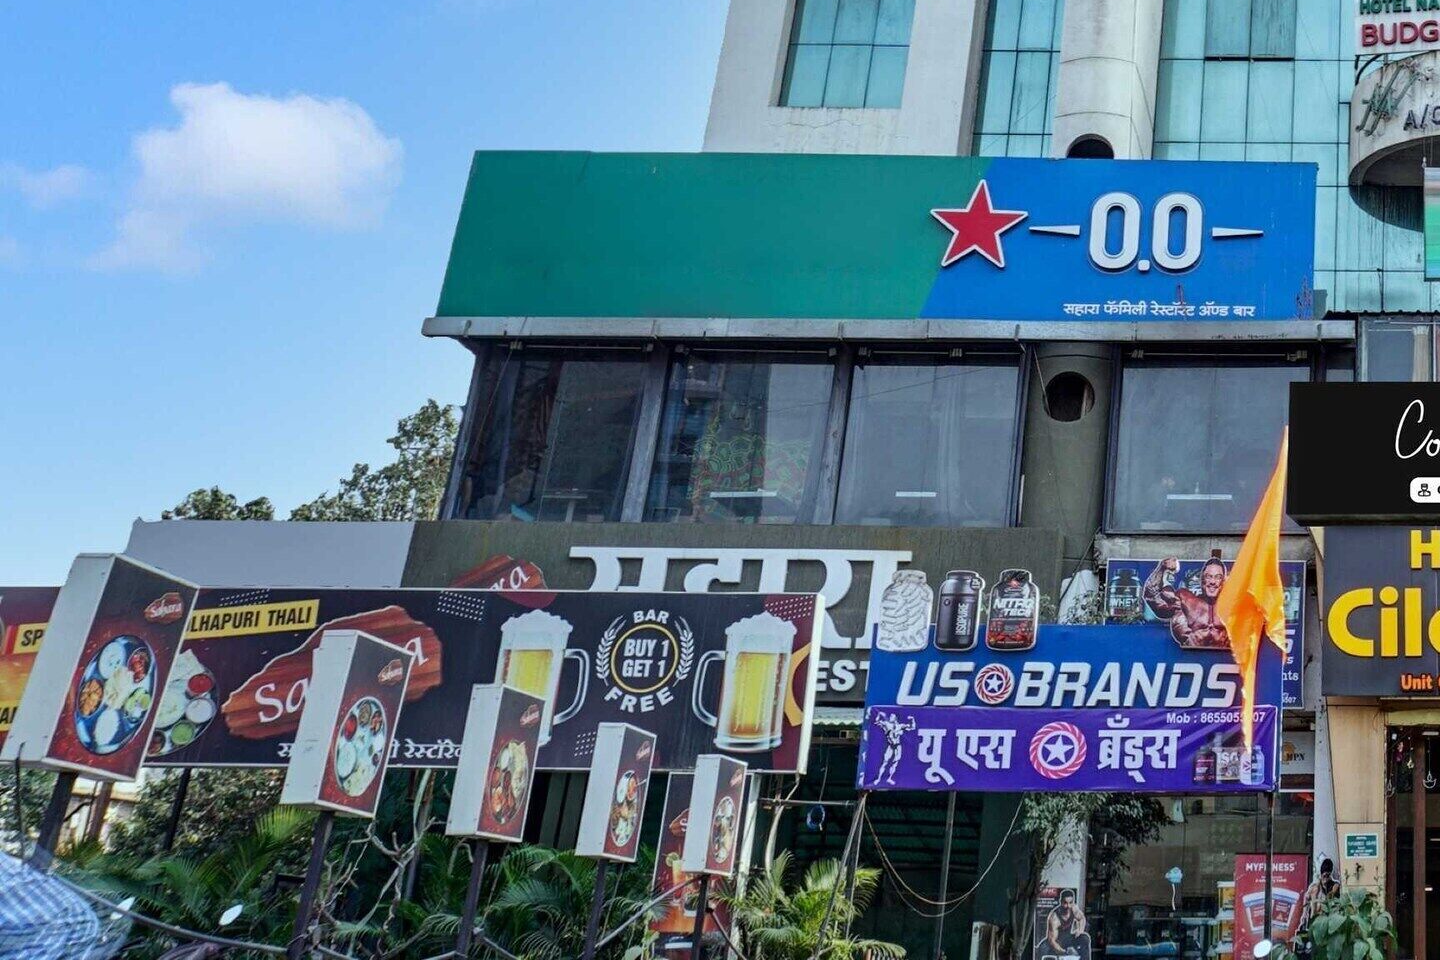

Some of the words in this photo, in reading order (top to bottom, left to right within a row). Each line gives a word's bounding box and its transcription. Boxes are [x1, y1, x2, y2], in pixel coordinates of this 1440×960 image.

[1063, 303, 1099, 316] सहारा
[1104, 299, 1147, 315] फॅमिली
[1233, 305, 1256, 316] बार
[1110, 596, 1138, 607] WHEY
[187, 615, 259, 633] LHAPURI
[268, 607, 312, 626] THALI
[633, 609, 669, 624] BAR
[956, 603, 970, 634] ISOPURE
[21, 629, 43, 647] SP
[624, 639, 657, 657] BUY
[661, 639, 669, 657] 1
[622, 659, 653, 677] GET
[657, 660, 666, 677] 1
[254, 636, 428, 724] Saa
[896, 661, 974, 706] US
[1014, 662, 1241, 708] BRANDS
[1401, 674, 1433, 690] Unit
[604, 686, 674, 713] FREE
[1167, 714, 1190, 723] Mob
[1200, 712, 1265, 723] 86550507
[917, 728, 955, 784] यू
[956, 728, 1016, 770] एस
[1245, 862, 1295, 872] MYFINESS
